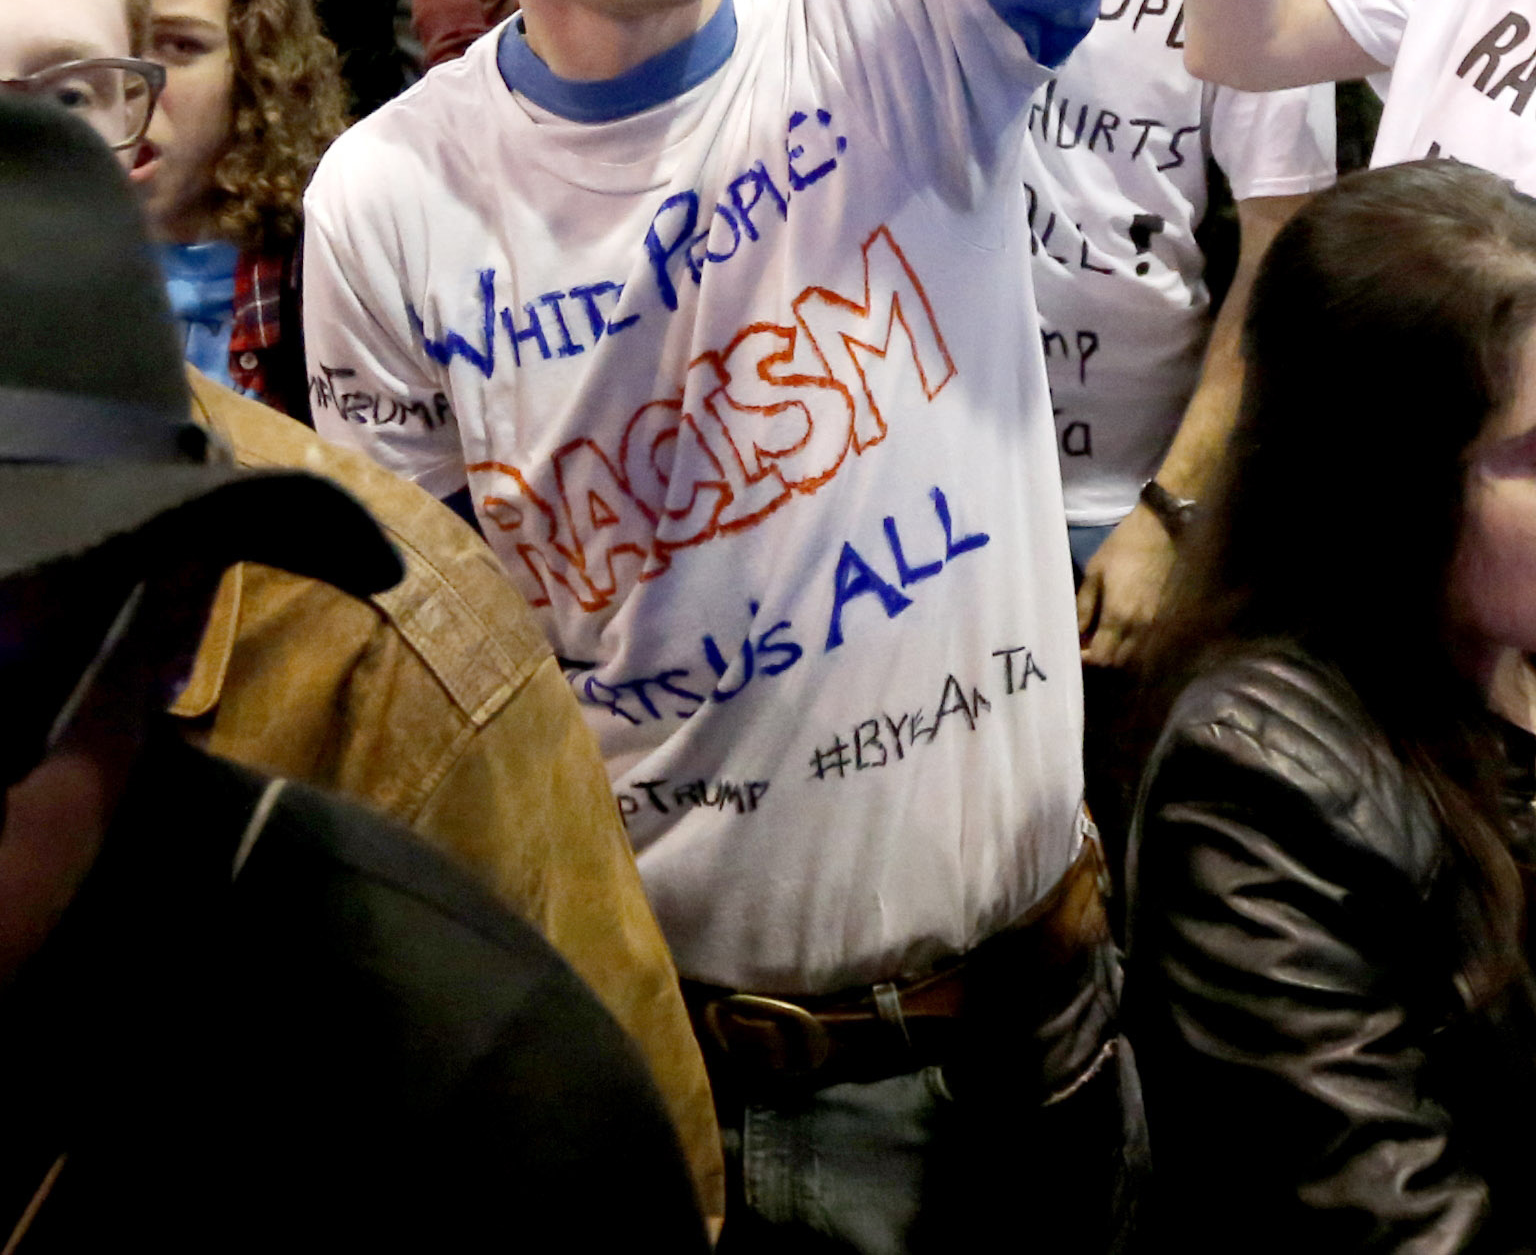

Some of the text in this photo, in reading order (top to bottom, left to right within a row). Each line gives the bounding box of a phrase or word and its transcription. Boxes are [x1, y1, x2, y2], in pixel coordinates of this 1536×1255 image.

[1028, 78, 1201, 173] HURTS
[464, 224, 958, 614] RACISM
[824, 486, 990, 653] ALL
